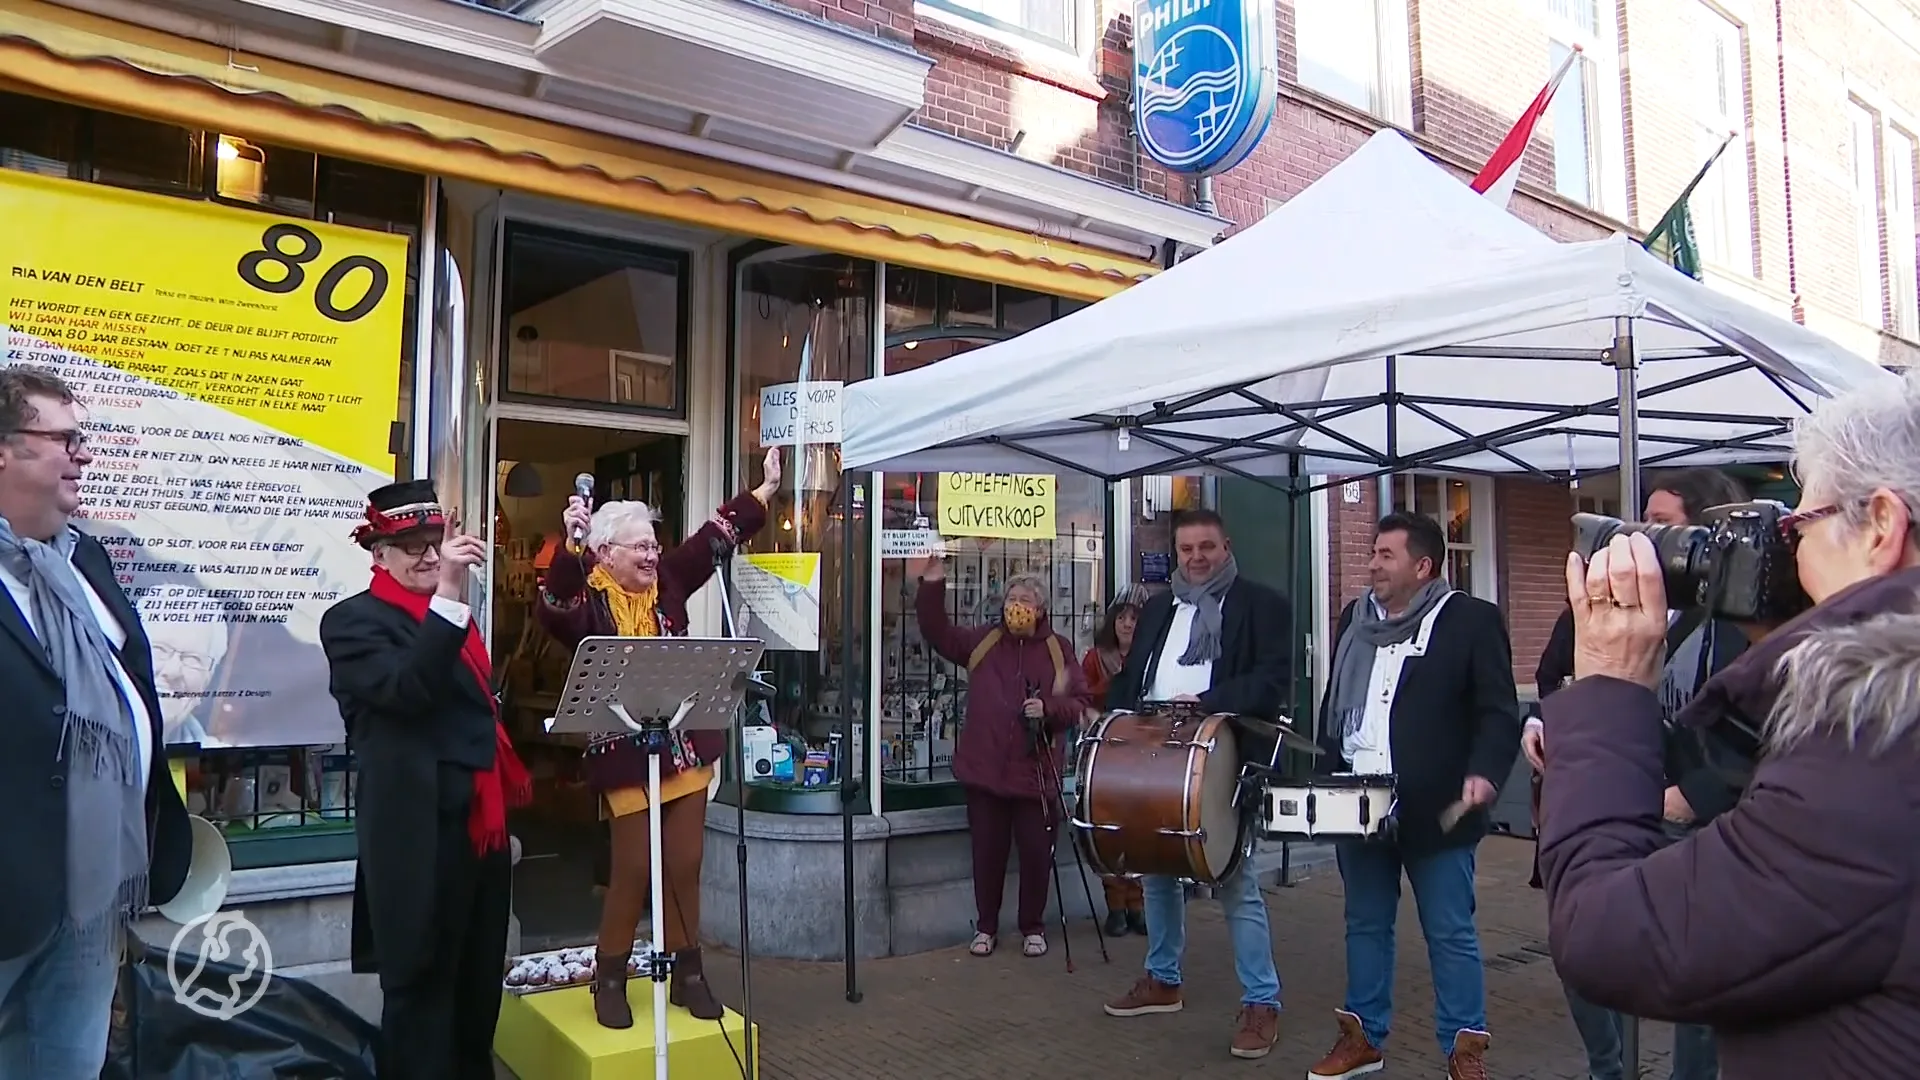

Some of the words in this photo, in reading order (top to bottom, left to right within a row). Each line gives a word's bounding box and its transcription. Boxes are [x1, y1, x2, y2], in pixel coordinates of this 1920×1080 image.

[12, 266, 38, 280] RIA
[42, 269, 72, 284] VAN
[75, 274, 106, 289] DEN
[109, 279, 145, 293] BELT
[237, 223, 388, 322] 80
[9, 297, 36, 310] HET
[37, 301, 81, 315] WORDT
[84, 306, 107, 318] EEN
[109, 310, 132, 321] GEK
[187, 319, 203, 329] DE
[205, 321, 234, 333] DEUR
[236, 325, 254, 335] DIE
[256, 327, 290, 340] BLIJFT
[291, 331, 340, 345] POTDICHT
[9, 310, 33, 322] WIJ
[35, 313, 67, 325] GAAN
[68, 318, 100, 330] HAAR
[102, 322, 148, 335] MISSEN
[7, 336, 32, 347] WIJ
[34, 339, 65, 351] GAAN
[67, 343, 99, 355] HAAR
[101, 347, 146, 360] MISSEN
[8, 323, 25, 334] NA
[27, 326, 63, 338] BIJNA
[66, 328, 88, 340] 80
[91, 333, 118, 344] JAAR
[175, 342, 203, 353] DOET
[205, 345, 220, 356] ZE
[232, 349, 247, 358] NU
[248, 351, 269, 361] PAS
[270, 352, 312, 365] KALMER
[312, 357, 333, 367] AAN
[7, 349, 24, 360] ZE
[26, 351, 67, 364] STOND
[69, 355, 101, 368] ELKE
[103, 360, 126, 371] DAG
[173, 366, 207, 379] ZOALS
[209, 370, 229, 381] DAT
[231, 373, 243, 382] IN
[245, 374, 278, 386] ZAKEN
[280, 377, 305, 388] GAAT
[62, 368, 122, 384] GLIMLACH
[123, 374, 141, 384] OP
[264, 387, 295, 399] ALLES
[296, 390, 326, 402] ROND
[336, 394, 364, 406] LICHT
[763, 391, 797, 407] ALLES
[807, 389, 836, 403] VOOR
[98, 396, 144, 410] MISSEN
[184, 391, 197, 402] JE
[199, 393, 236, 405] KREEG
[236, 397, 258, 408] HET
[259, 399, 271, 409] IN
[272, 400, 299, 412] ELKE
[300, 402, 327, 413] MAAT
[790, 405, 808, 420] DE
[96, 434, 142, 447] MISSEN
[141, 425, 172, 438] VOOR
[174, 428, 190, 439] DE
[192, 430, 226, 442] DUVEL
[228, 433, 251, 443] NOG
[252, 434, 276, 446] NIET
[277, 436, 305, 448] BANG
[761, 425, 795, 443] HALVE
[132, 449, 149, 460] ER
[150, 451, 177, 462] NIET
[208, 455, 230, 465] DAN
[231, 457, 267, 468] KREEG
[267, 459, 282, 469] JE
[282, 460, 309, 471] HAAR
[310, 462, 334, 473] NIET
[334, 464, 364, 475] KLEIN
[86, 471, 110, 482] DAN
[112, 473, 130, 484] DE
[165, 476, 189, 488] HET
[189, 478, 214, 489] WAS
[215, 480, 244, 490] HAAR
[245, 481, 303, 494] EERGEVOEL
[950, 471, 1046, 497] OPHEFFINGS
[99, 497, 113, 508] IS
[114, 498, 131, 509] NU
[132, 499, 162, 510] RUST
[213, 504, 262, 516] NIEMAND
[262, 506, 282, 517] DIE
[283, 507, 304, 518] DAT
[304, 509, 330, 519] HAAR
[121, 486, 149, 498] ZICH
[189, 490, 203, 500] JE
[205, 491, 231, 503] GING
[232, 493, 258, 504] NIET
[258, 495, 285, 505] NAAR
[286, 496, 307, 507] EEN
[308, 497, 365, 509] WARENHUIS
[92, 510, 138, 521] MISSEN
[947, 504, 1046, 529] UITVERKOOP
[99, 535, 128, 546] GAAT
[128, 537, 146, 548] NU
[147, 537, 165, 548] OP
[198, 540, 228, 551] VOOR
[229, 541, 248, 551] RIA
[249, 542, 271, 552] EEN
[272, 543, 306, 553] GENOT
[181, 563, 197, 574] ZE
[198, 564, 223, 575] WAS
[223, 565, 260, 576] ALTIJD
[260, 566, 273, 576] IN
[274, 567, 289, 577] DE
[290, 567, 320, 578] WEER
[168, 587, 184, 598] OP
[186, 588, 206, 599] DIE
[207, 588, 256, 600] LEEFTIJD
[257, 590, 284, 600] TOCH
[285, 590, 307, 601] EEN
[144, 600, 163, 611] ZIJ
[163, 600, 200, 611] HEEFT
[200, 601, 224, 612] HET
[223, 601, 253, 612] GOED
[254, 602, 295, 612] GEDAAN
[148, 613, 161, 623] IK
[163, 613, 191, 623] VOEL
[192, 613, 216, 624] HET
[216, 614, 229, 624] IN
[230, 614, 258, 624] MIJN
[259, 614, 288, 624] MAAG
